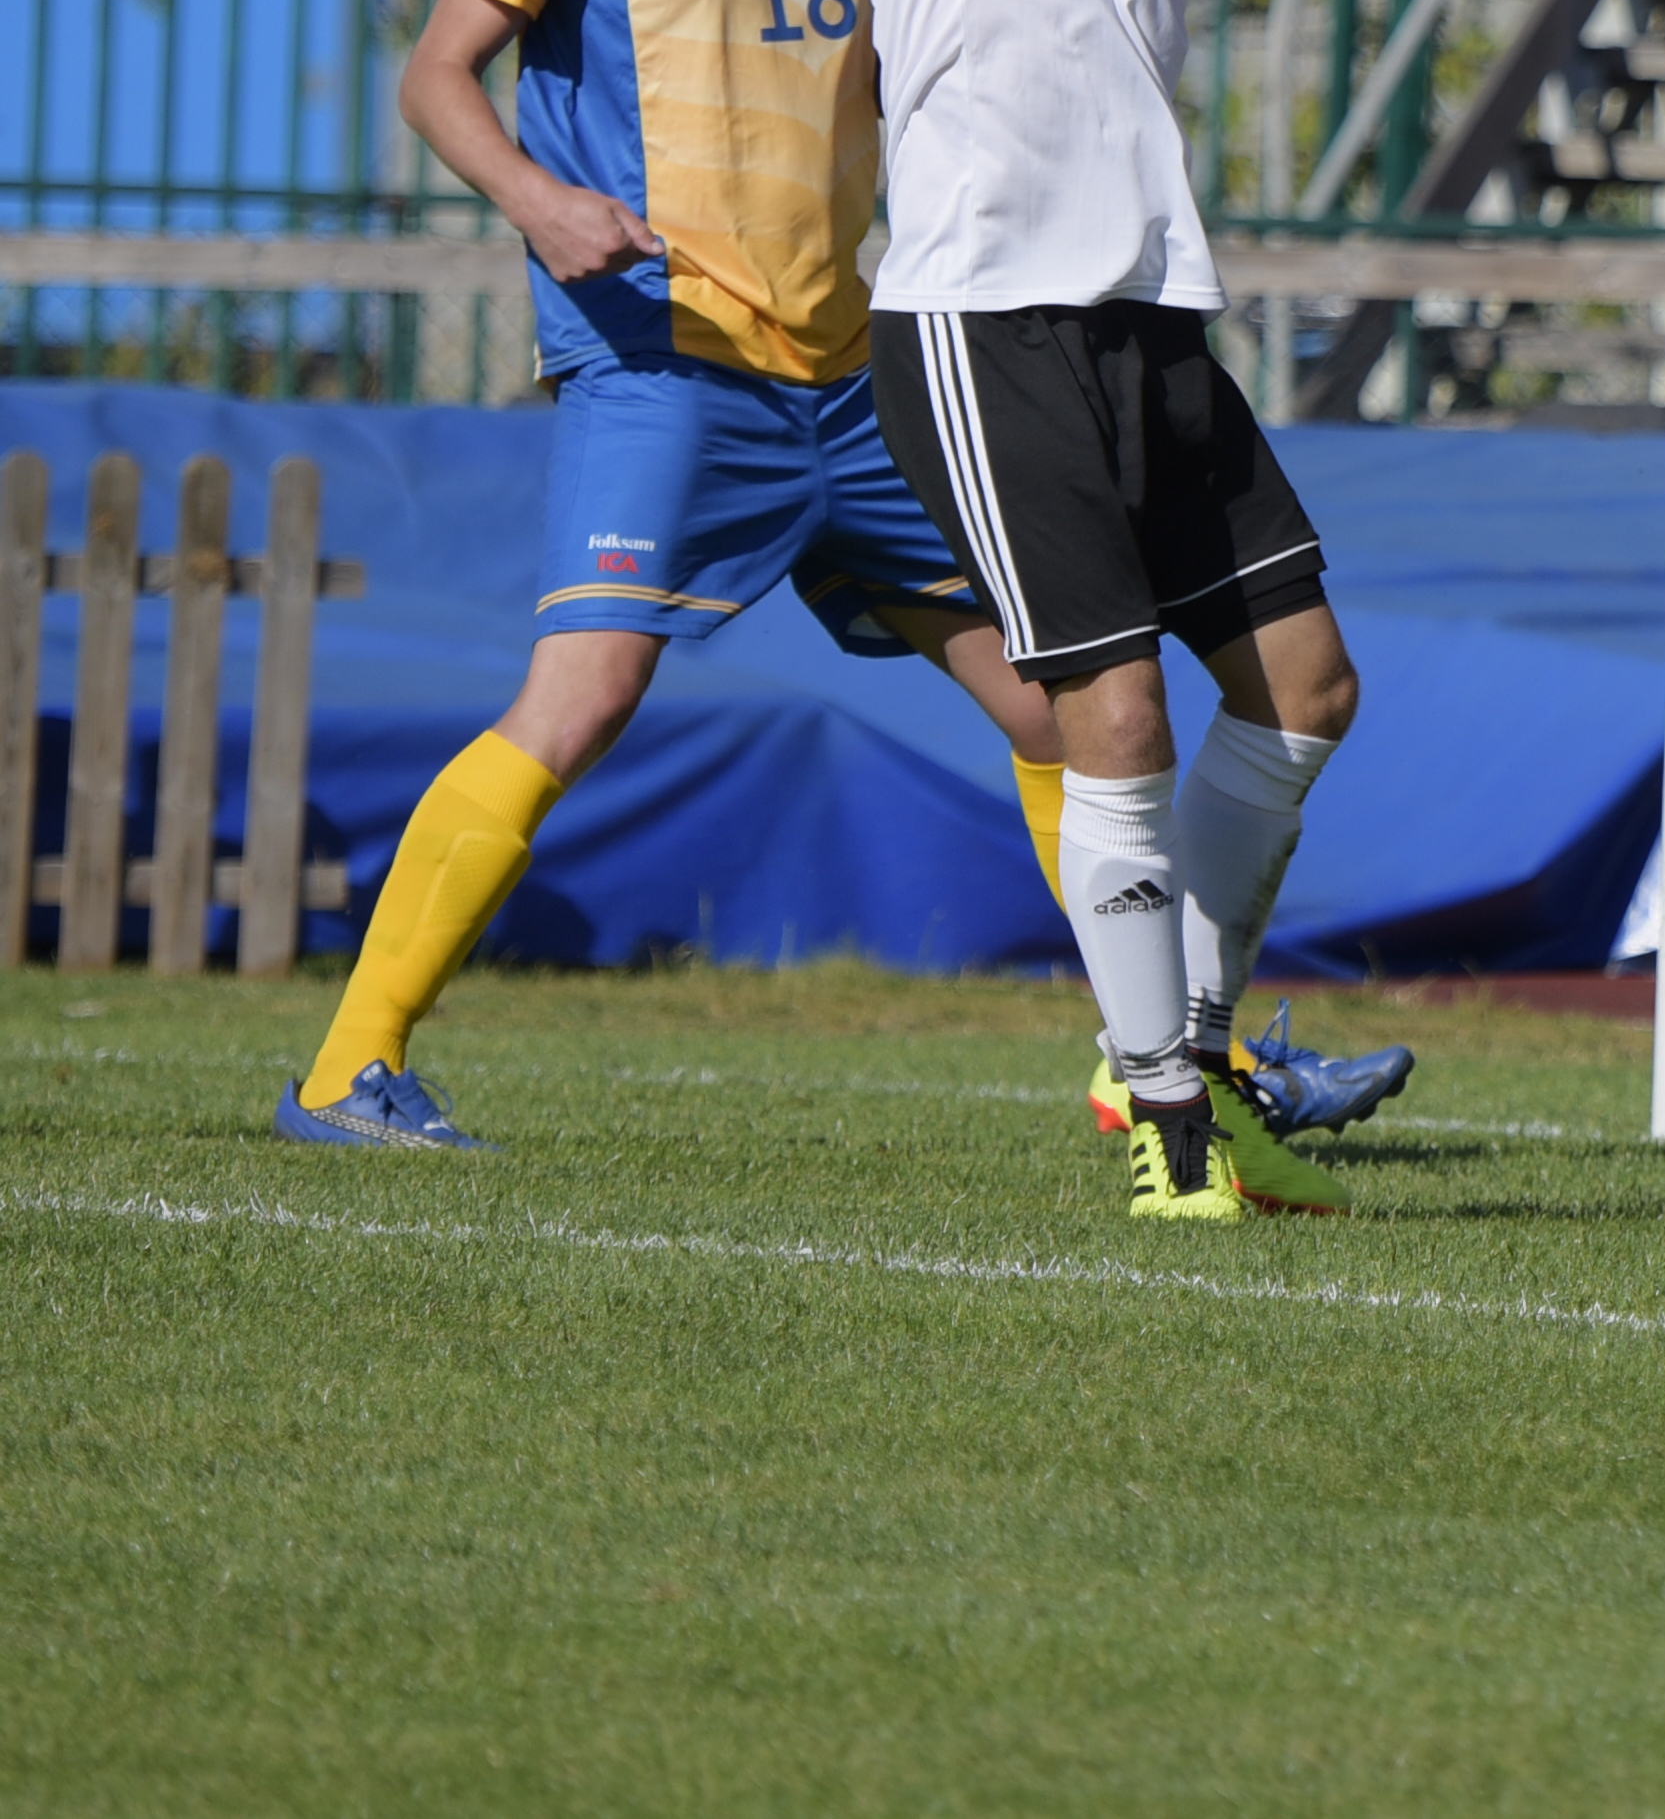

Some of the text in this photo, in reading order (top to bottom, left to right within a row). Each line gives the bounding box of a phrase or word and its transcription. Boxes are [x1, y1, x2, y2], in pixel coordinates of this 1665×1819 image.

[588, 533, 656, 552] Folksam
[597, 551, 639, 575] ICA
[1093, 893, 1174, 916] adidas
